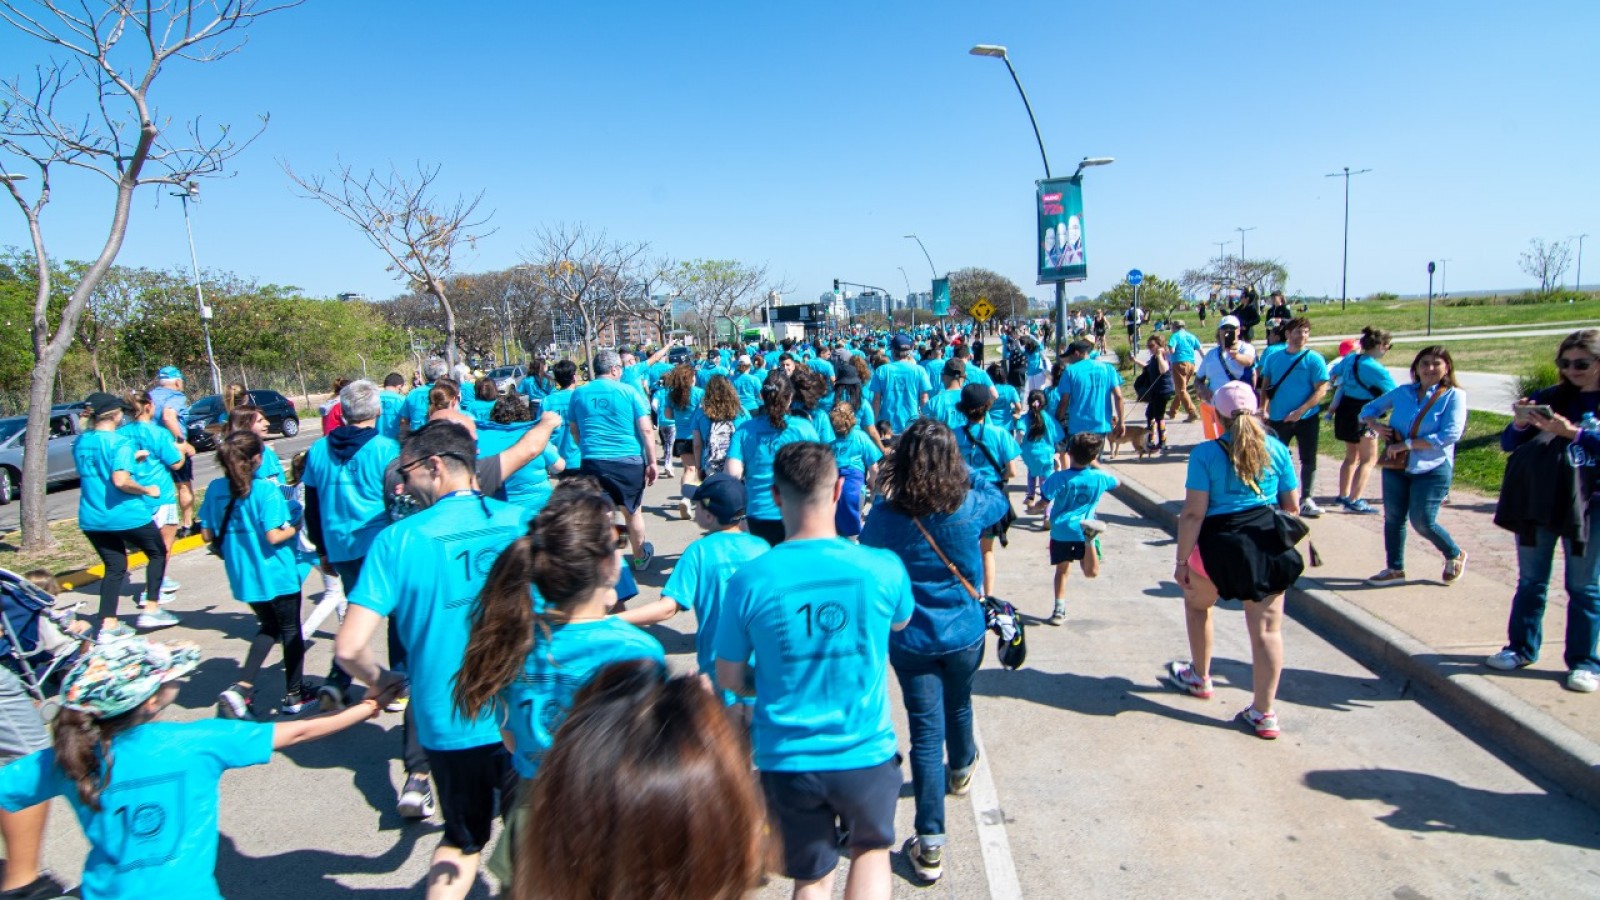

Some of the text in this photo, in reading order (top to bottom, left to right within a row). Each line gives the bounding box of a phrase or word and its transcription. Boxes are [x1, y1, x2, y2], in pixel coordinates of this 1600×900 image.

[591, 398, 609, 409] 10
[455, 547, 500, 581] 10
[796, 601, 848, 637] 10
[114, 802, 166, 839] 10
